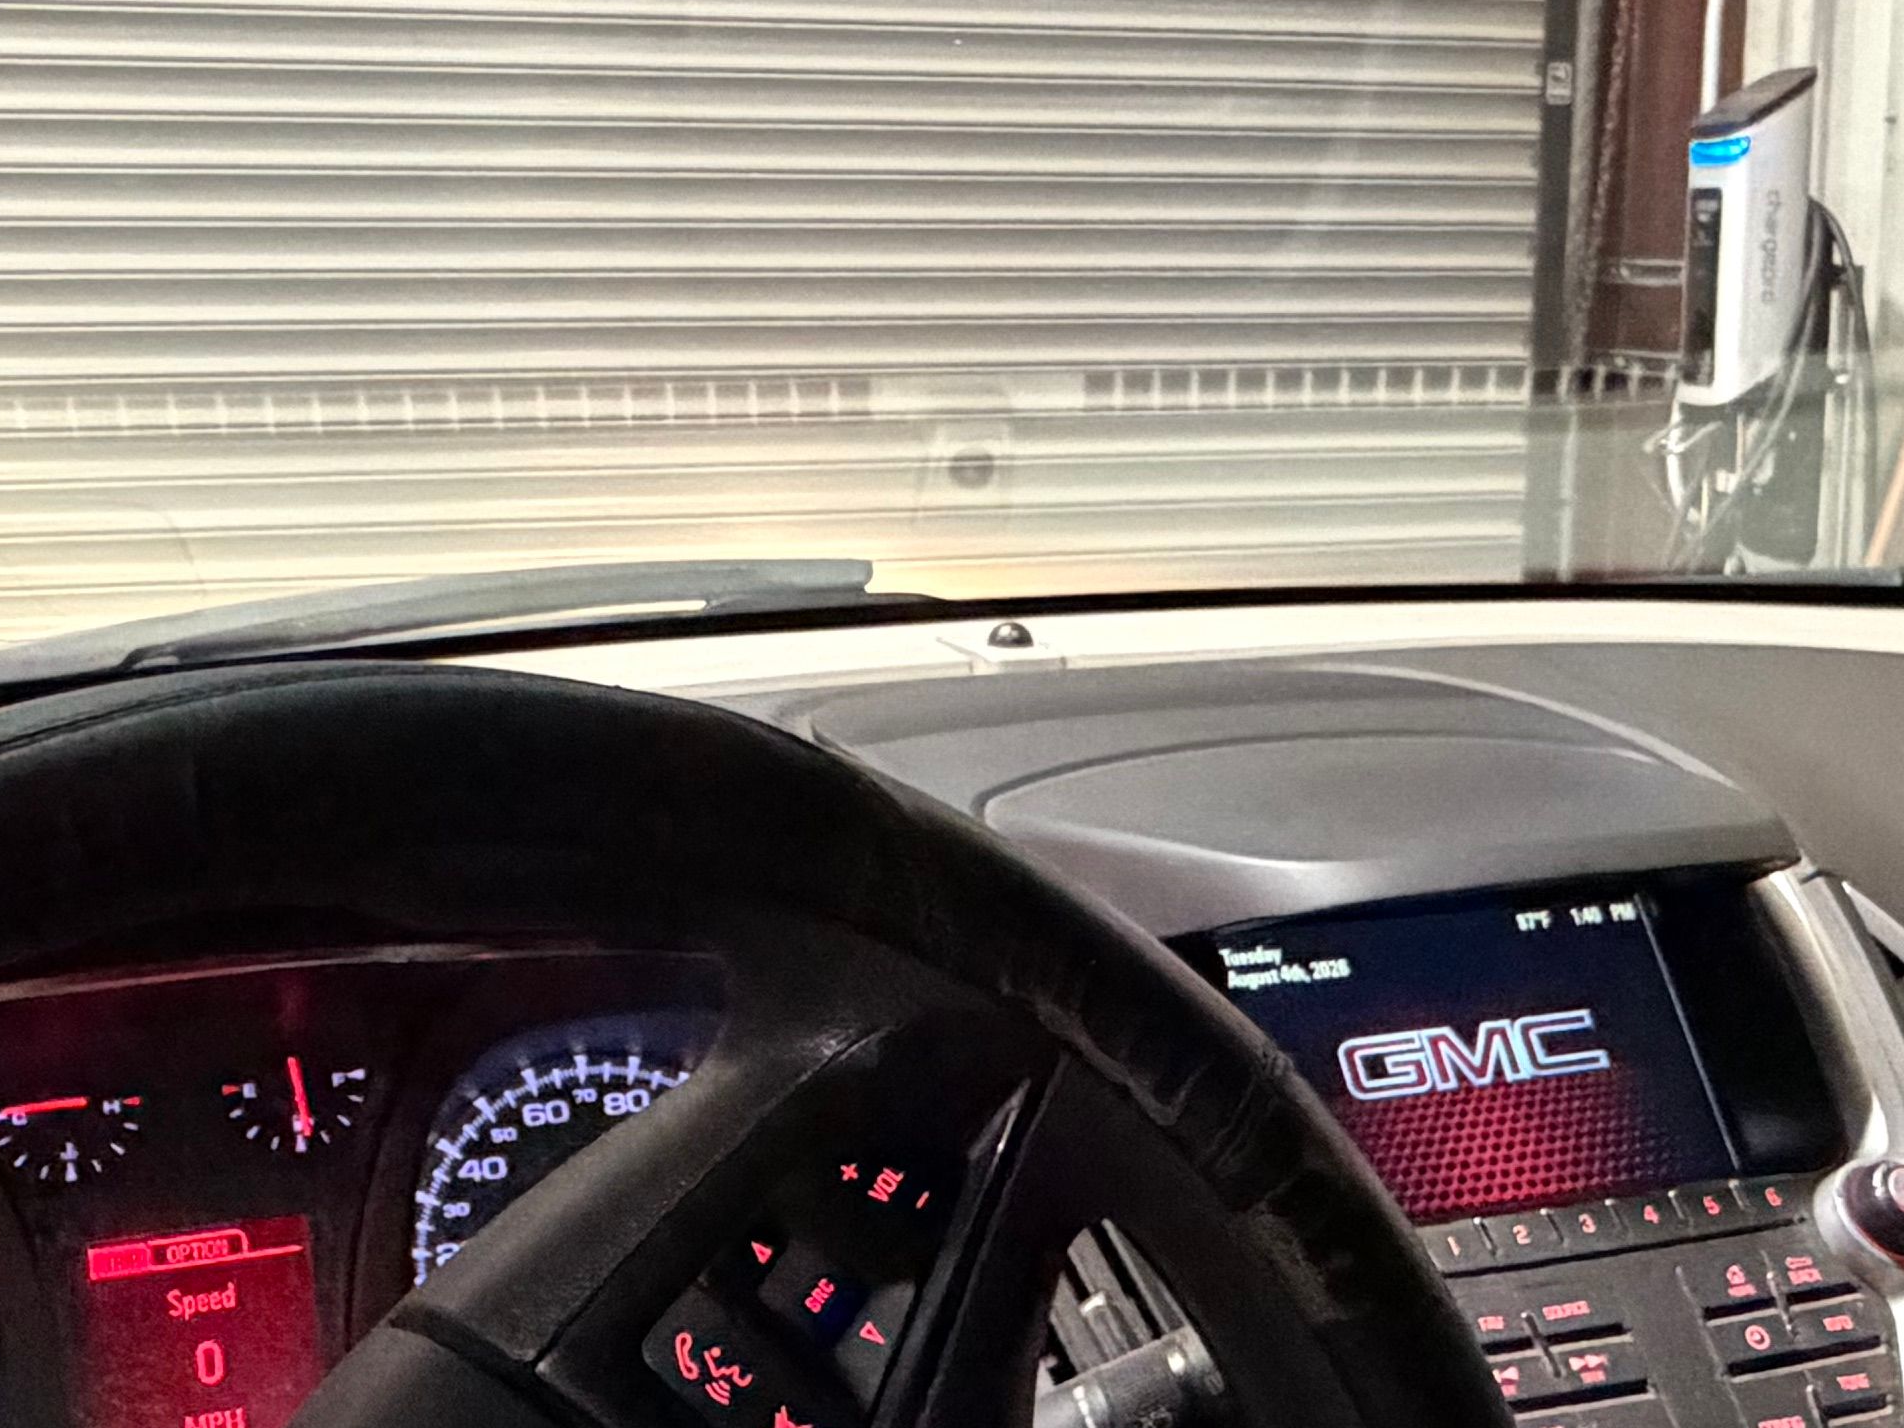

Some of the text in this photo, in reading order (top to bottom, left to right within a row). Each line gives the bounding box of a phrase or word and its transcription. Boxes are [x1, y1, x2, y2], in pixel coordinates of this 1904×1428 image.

[1218, 944, 1282, 967] Tuesday
[1227, 968, 1280, 990] August
[1338, 1008, 1611, 1102] GMC
[102, 1099, 121, 1115] H
[572, 1087, 598, 1105] 70
[603, 1088, 651, 1117] 80
[521, 1100, 571, 1128] 60
[490, 1126, 518, 1144] 50
[457, 1155, 508, 1183] 40
[867, 1166, 905, 1204] VOL
[1764, 1185, 1784, 1208] 6
[442, 1201, 471, 1220] 30
[1643, 1204, 1661, 1225] 4
[1702, 1194, 1722, 1217] 5
[1512, 1224, 1532, 1245] 2
[1578, 1212, 1598, 1234] 3
[165, 1238, 229, 1264] OPTION
[1446, 1235, 1462, 1258] 1
[166, 1280, 237, 1321] Speed
[804, 1277, 836, 1314] SRC
[195, 1339, 226, 1386] 0
